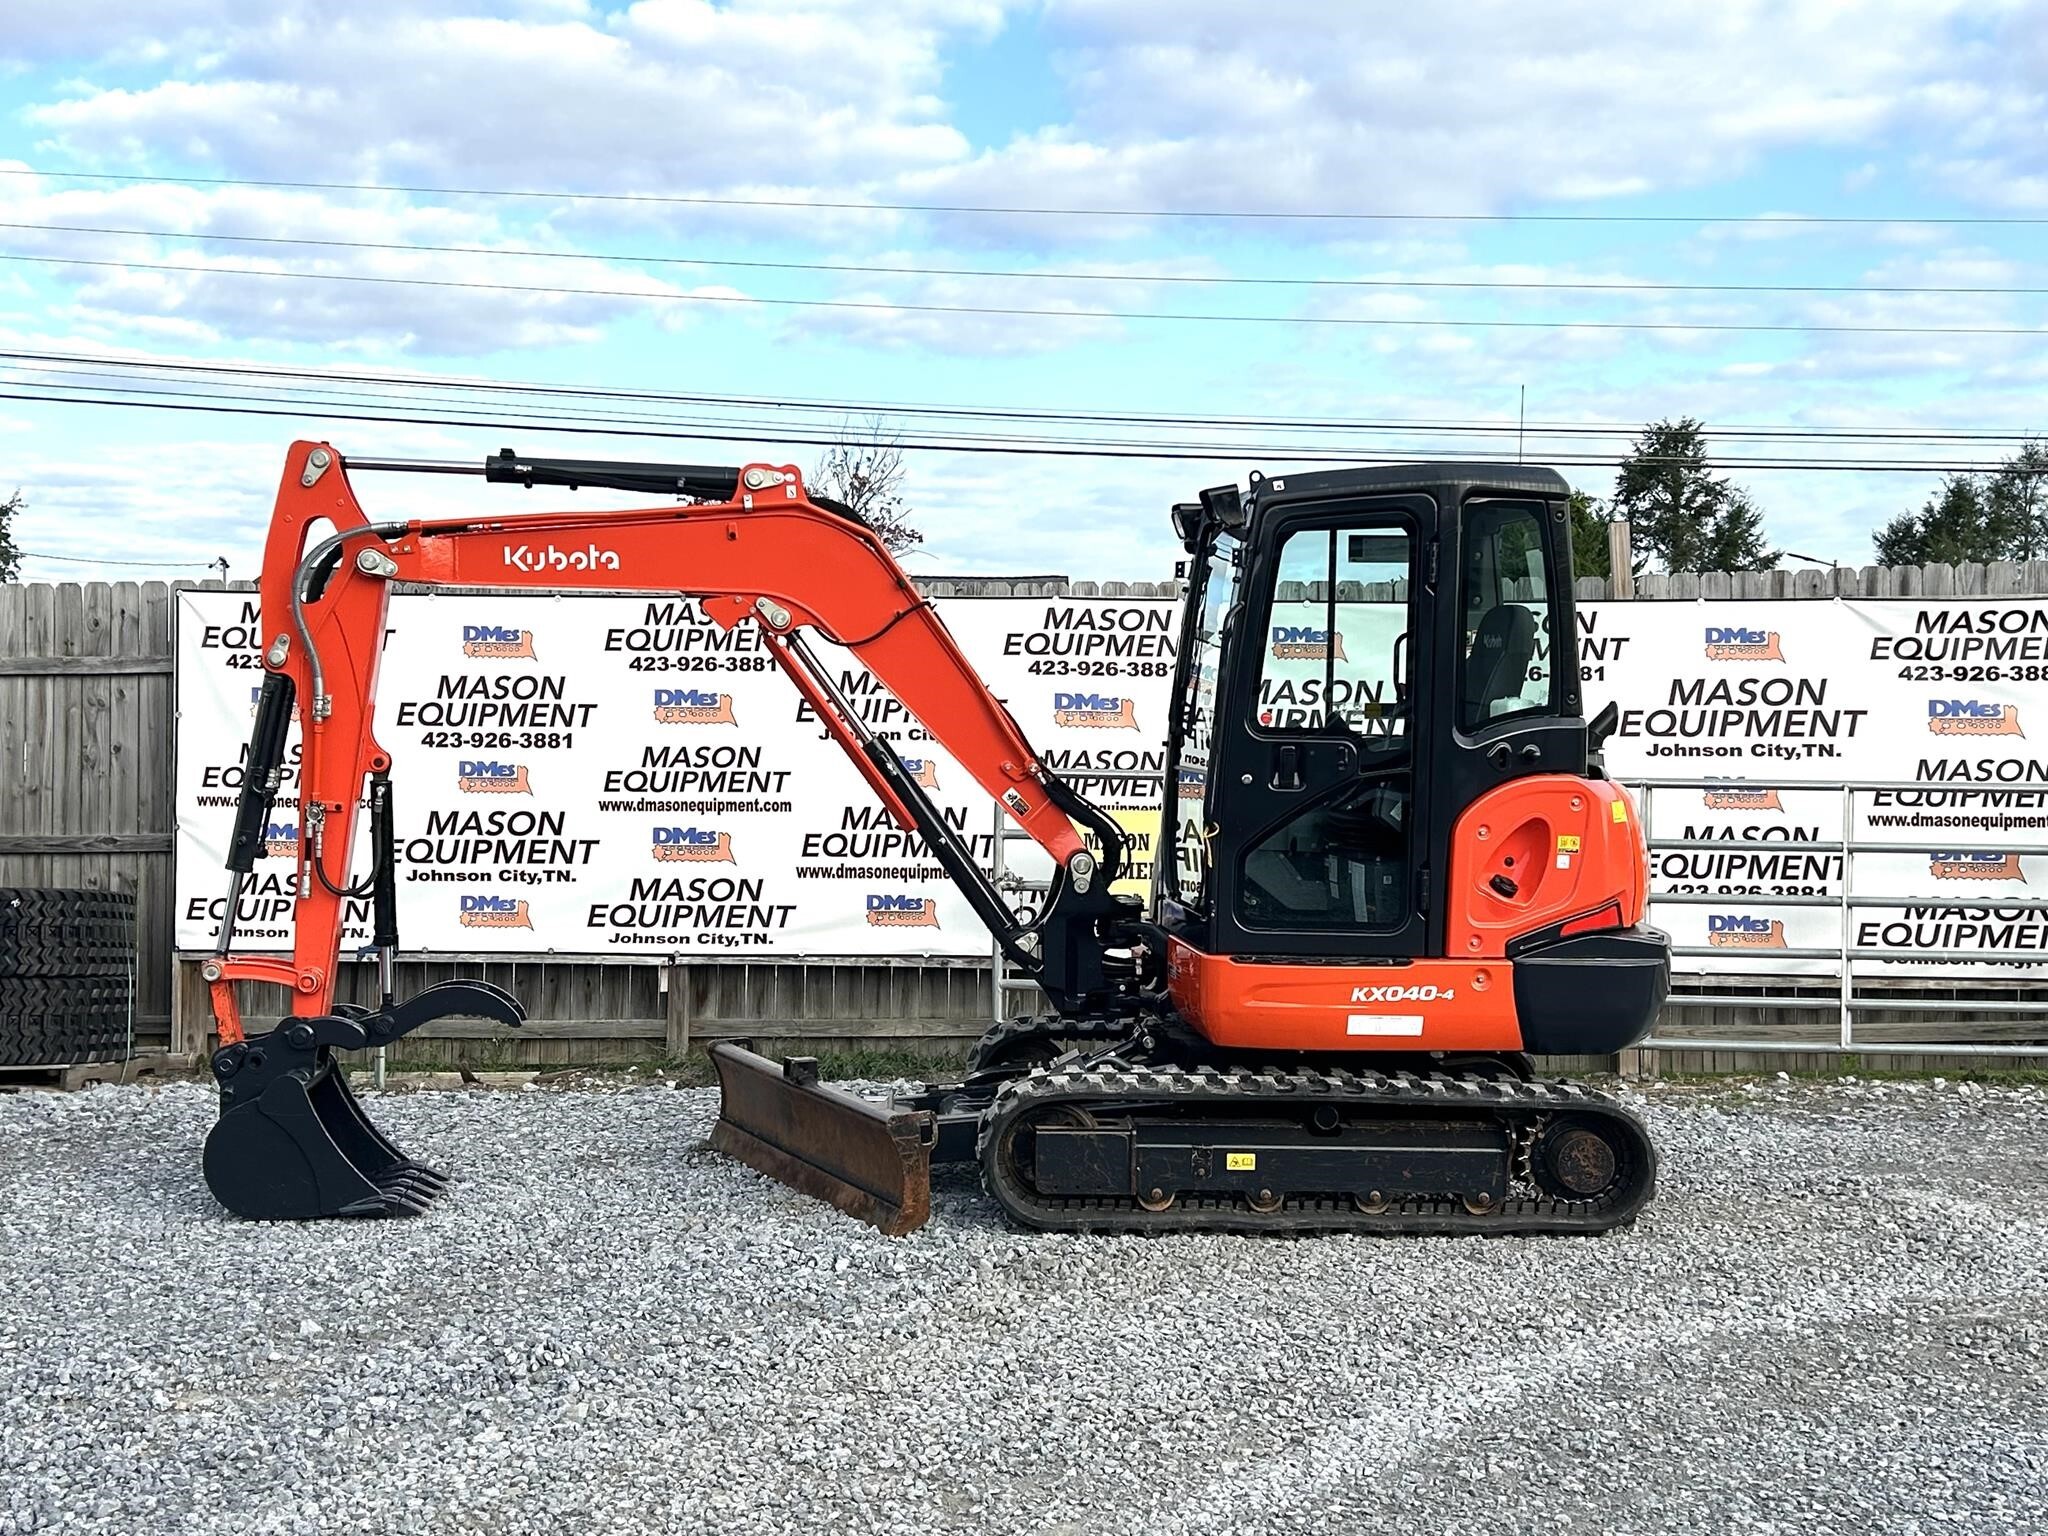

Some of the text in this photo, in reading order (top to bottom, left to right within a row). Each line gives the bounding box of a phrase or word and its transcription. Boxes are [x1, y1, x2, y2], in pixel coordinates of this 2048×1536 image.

[503, 544, 620, 572] Kubota
[1043, 607, 1173, 632] MASON
[463, 625, 520, 641] DMes
[1705, 627, 1766, 644] DMes
[1003, 633, 1179, 657] EQUIPMEN
[629, 656, 777, 672] 423-926-3881
[1028, 660, 1176, 677] 423-926-388
[436, 675, 566, 700] MASON
[1667, 678, 1828, 706] MASON
[654, 689, 718, 706] DMes
[1054, 693, 1120, 711] DMes
[396, 702, 598, 728] EQUIPMENT
[1928, 700, 2001, 717] DMes
[1619, 710, 1868, 737] EQUIPMENT
[421, 732, 573, 749] 423-926-3881
[641, 746, 762, 768] MASON
[1043, 749, 1165, 770] MASON
[1646, 744, 1842, 760] Johnson City,TN.
[458, 761, 516, 777] DMes
[1916, 759, 2048, 782] MASON
[603, 771, 791, 793] EQUIPMENT
[599, 798, 792, 815] www.dmasonequipment.com
[426, 811, 566, 836] MASON
[841, 806, 968, 831] MAN
[1867, 812, 2048, 831] www.dmasonequipmen
[652, 827, 717, 844] DMes
[801, 833, 994, 858] EQUIPMNT
[406, 870, 577, 885] Johnson City,TN.
[629, 878, 764, 902] MASON
[460, 896, 516, 911] DMes
[866, 894, 923, 911] DMes
[587, 904, 797, 929] EQUIPMENT
[1709, 915, 1770, 932] DMes
[208, 926, 289, 938] Jhnson
[608, 933, 774, 947] Johnson City,TN.
[1350, 985, 1455, 1002] KX040-4
